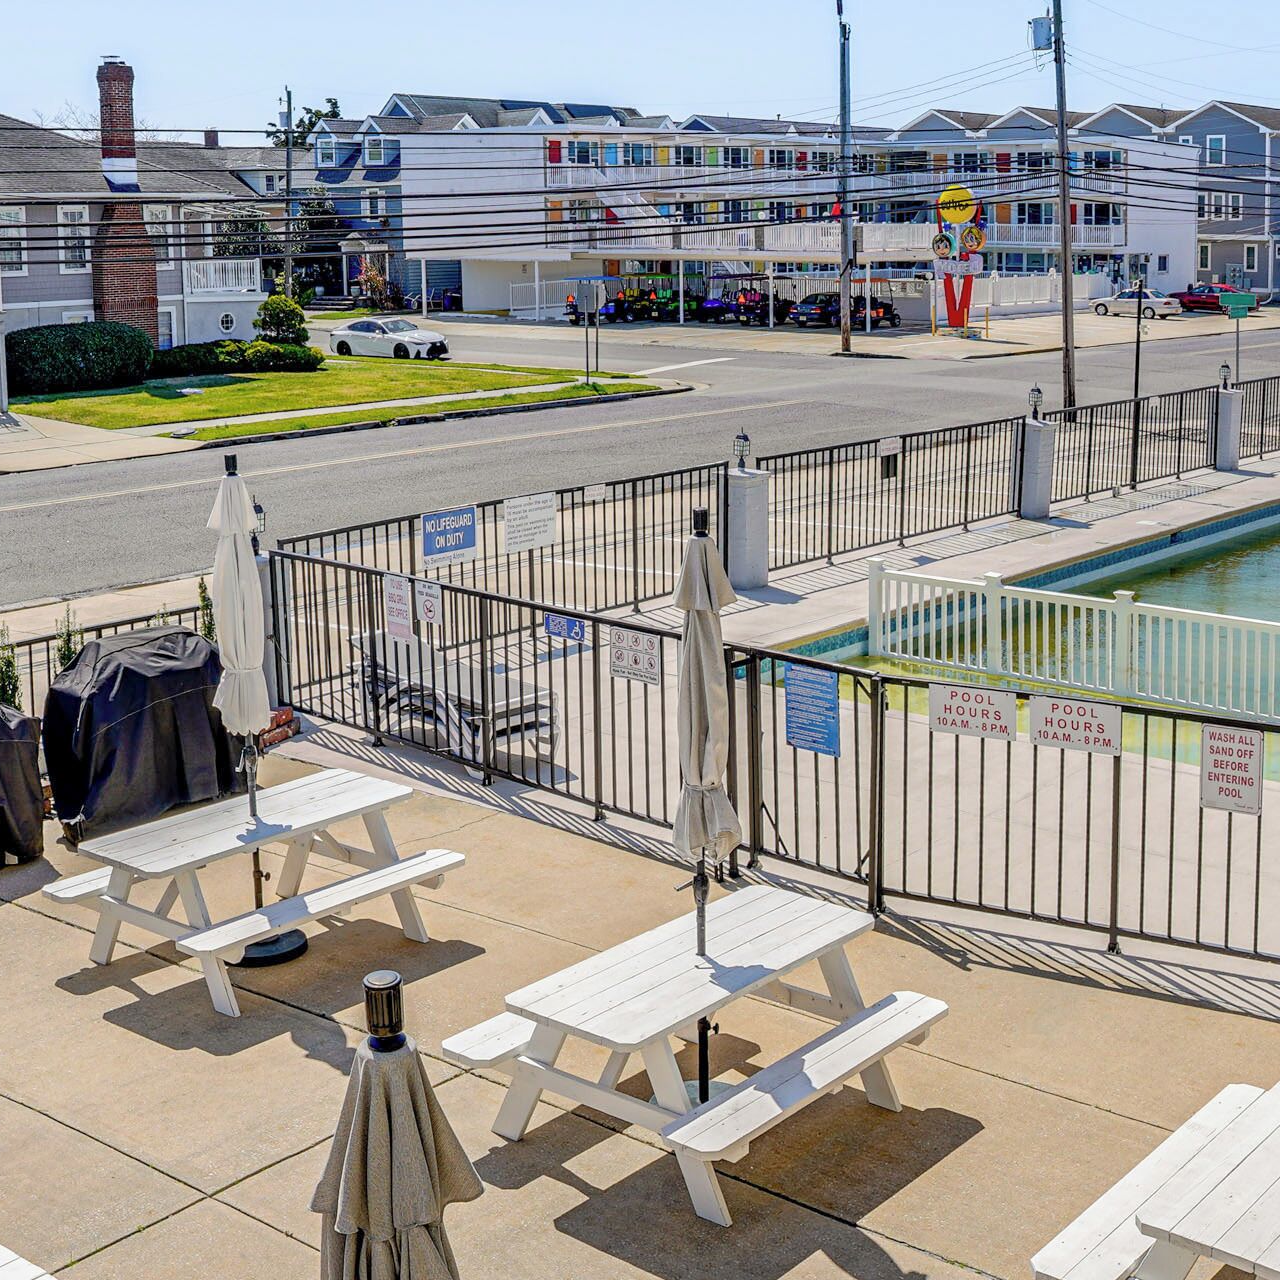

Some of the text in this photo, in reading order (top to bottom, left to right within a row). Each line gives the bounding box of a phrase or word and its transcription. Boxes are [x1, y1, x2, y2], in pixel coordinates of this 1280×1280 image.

[426, 514, 472, 534] NO LIFEGUARD
[436, 532, 464, 548] ON DUTY
[430, 555, 452, 564] Swimming
[950, 690, 994, 706] POOL
[944, 704, 1002, 721] HOURS
[1052, 703, 1098, 718] POOL
[937, 717, 948, 726] 10
[950, 718, 972, 730] A.M.
[981, 723, 986, 732] 8
[1045, 717, 1105, 734] HOURS
[1038, 730, 1048, 740] 10
[1052, 732, 1074, 743] A.M.
[1084, 736, 1090, 745] 8
[1093, 738, 1114, 748] P.M.
[1209, 731, 1255, 746] WASH ALL
[1210, 745, 1254, 759] SAND OFF
[1214, 759, 1249, 772] BEFORE
[1208, 772, 1254, 787] ENTERING
[1219, 787, 1242, 798] POOL
